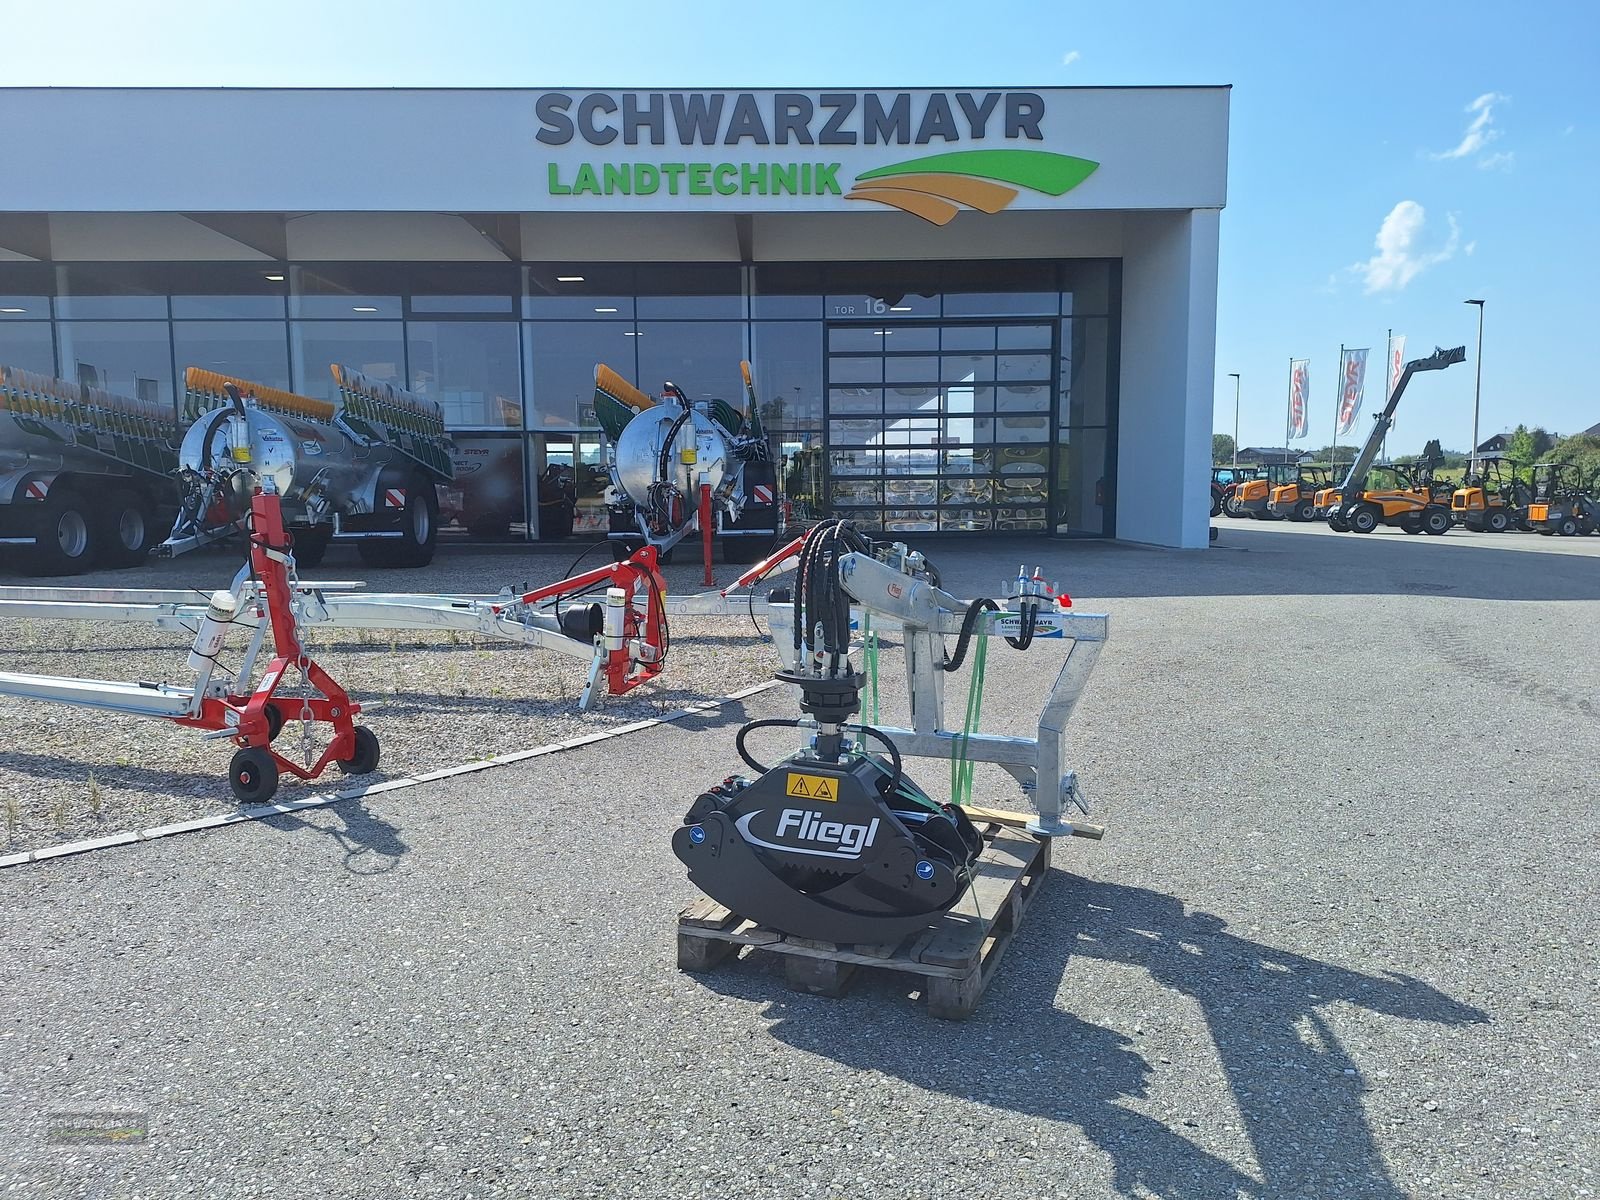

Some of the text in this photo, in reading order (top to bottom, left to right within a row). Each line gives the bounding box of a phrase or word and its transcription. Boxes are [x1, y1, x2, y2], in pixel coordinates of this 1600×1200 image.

[535, 92, 1046, 146] SCHWARZMAYR
[547, 162, 842, 197] LANDTECHNIK
[834, 298, 886, 314] TOR 16
[1340, 360, 1360, 425] STEYR
[1000, 618, 1053, 626] SCHWMAYR
[775, 808, 880, 854] Fliegl
